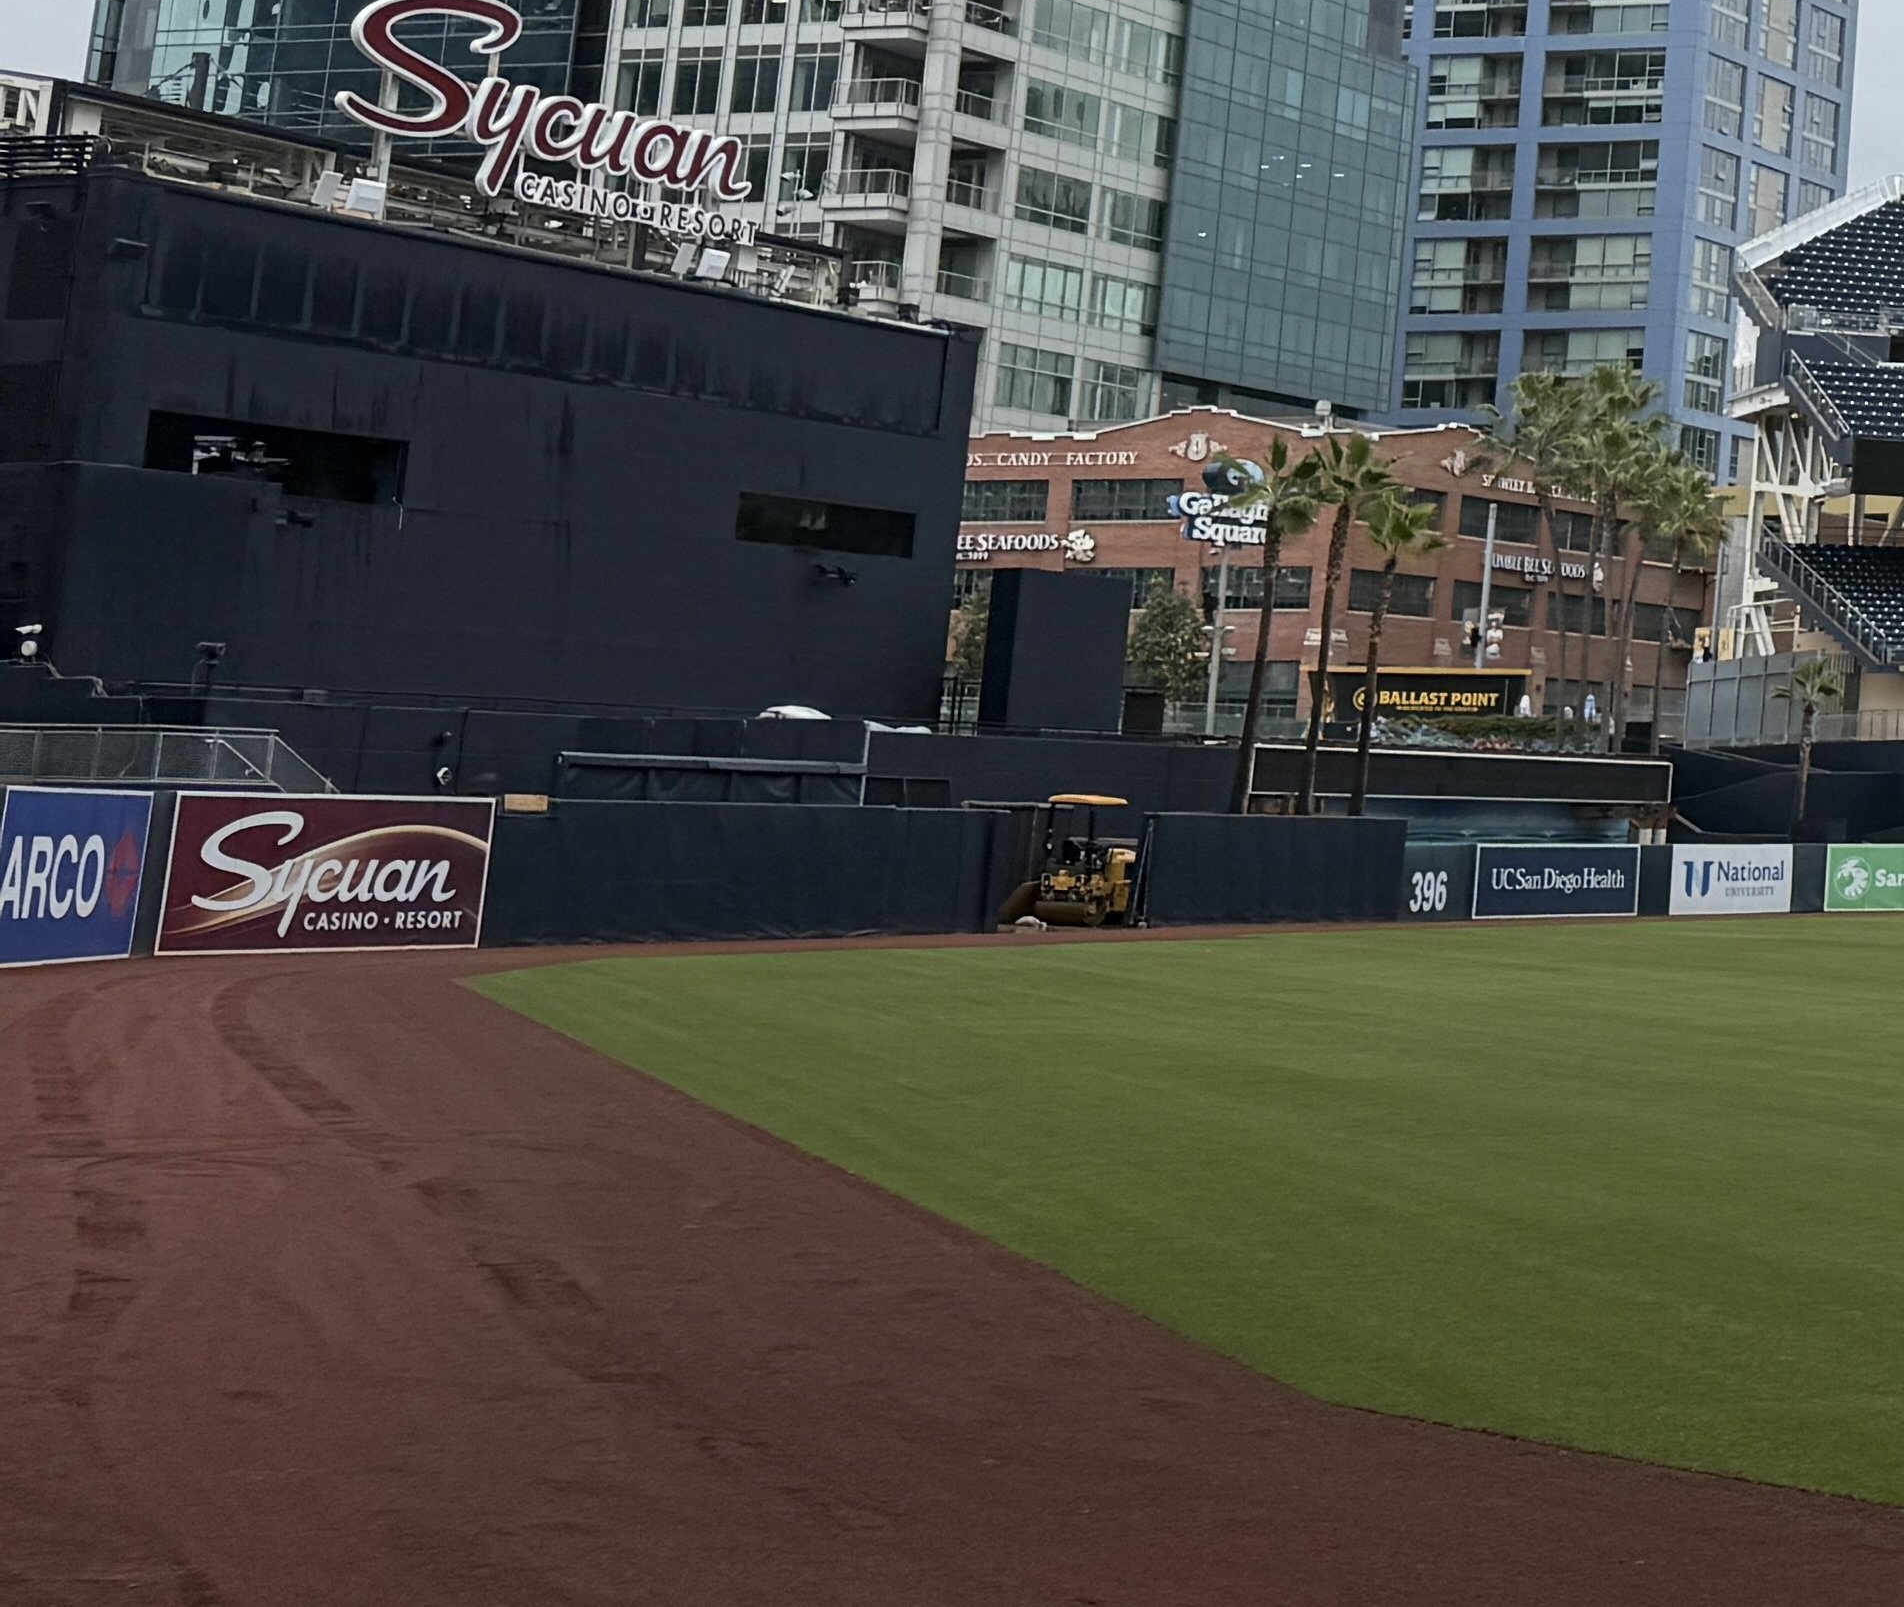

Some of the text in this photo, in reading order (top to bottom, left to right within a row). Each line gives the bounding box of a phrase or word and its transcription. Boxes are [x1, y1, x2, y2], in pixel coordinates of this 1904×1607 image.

[516, 173, 760, 245] CASINO RESORT
[997, 452, 1052, 466] CANDY
[1066, 450, 1139, 466] FACTORY
[976, 534, 1059, 551] SEAFOODS
[1379, 690, 1499, 707] BALLAST POINT
[0, 834, 105, 920] ARCO
[191, 811, 457, 938] Sycuan
[1491, 867, 1625, 894] UC San Diego Health
[1717, 860, 1784, 882] National
[1409, 871, 1448, 913] 396
[303, 909, 464, 931] CASINO RESORT
